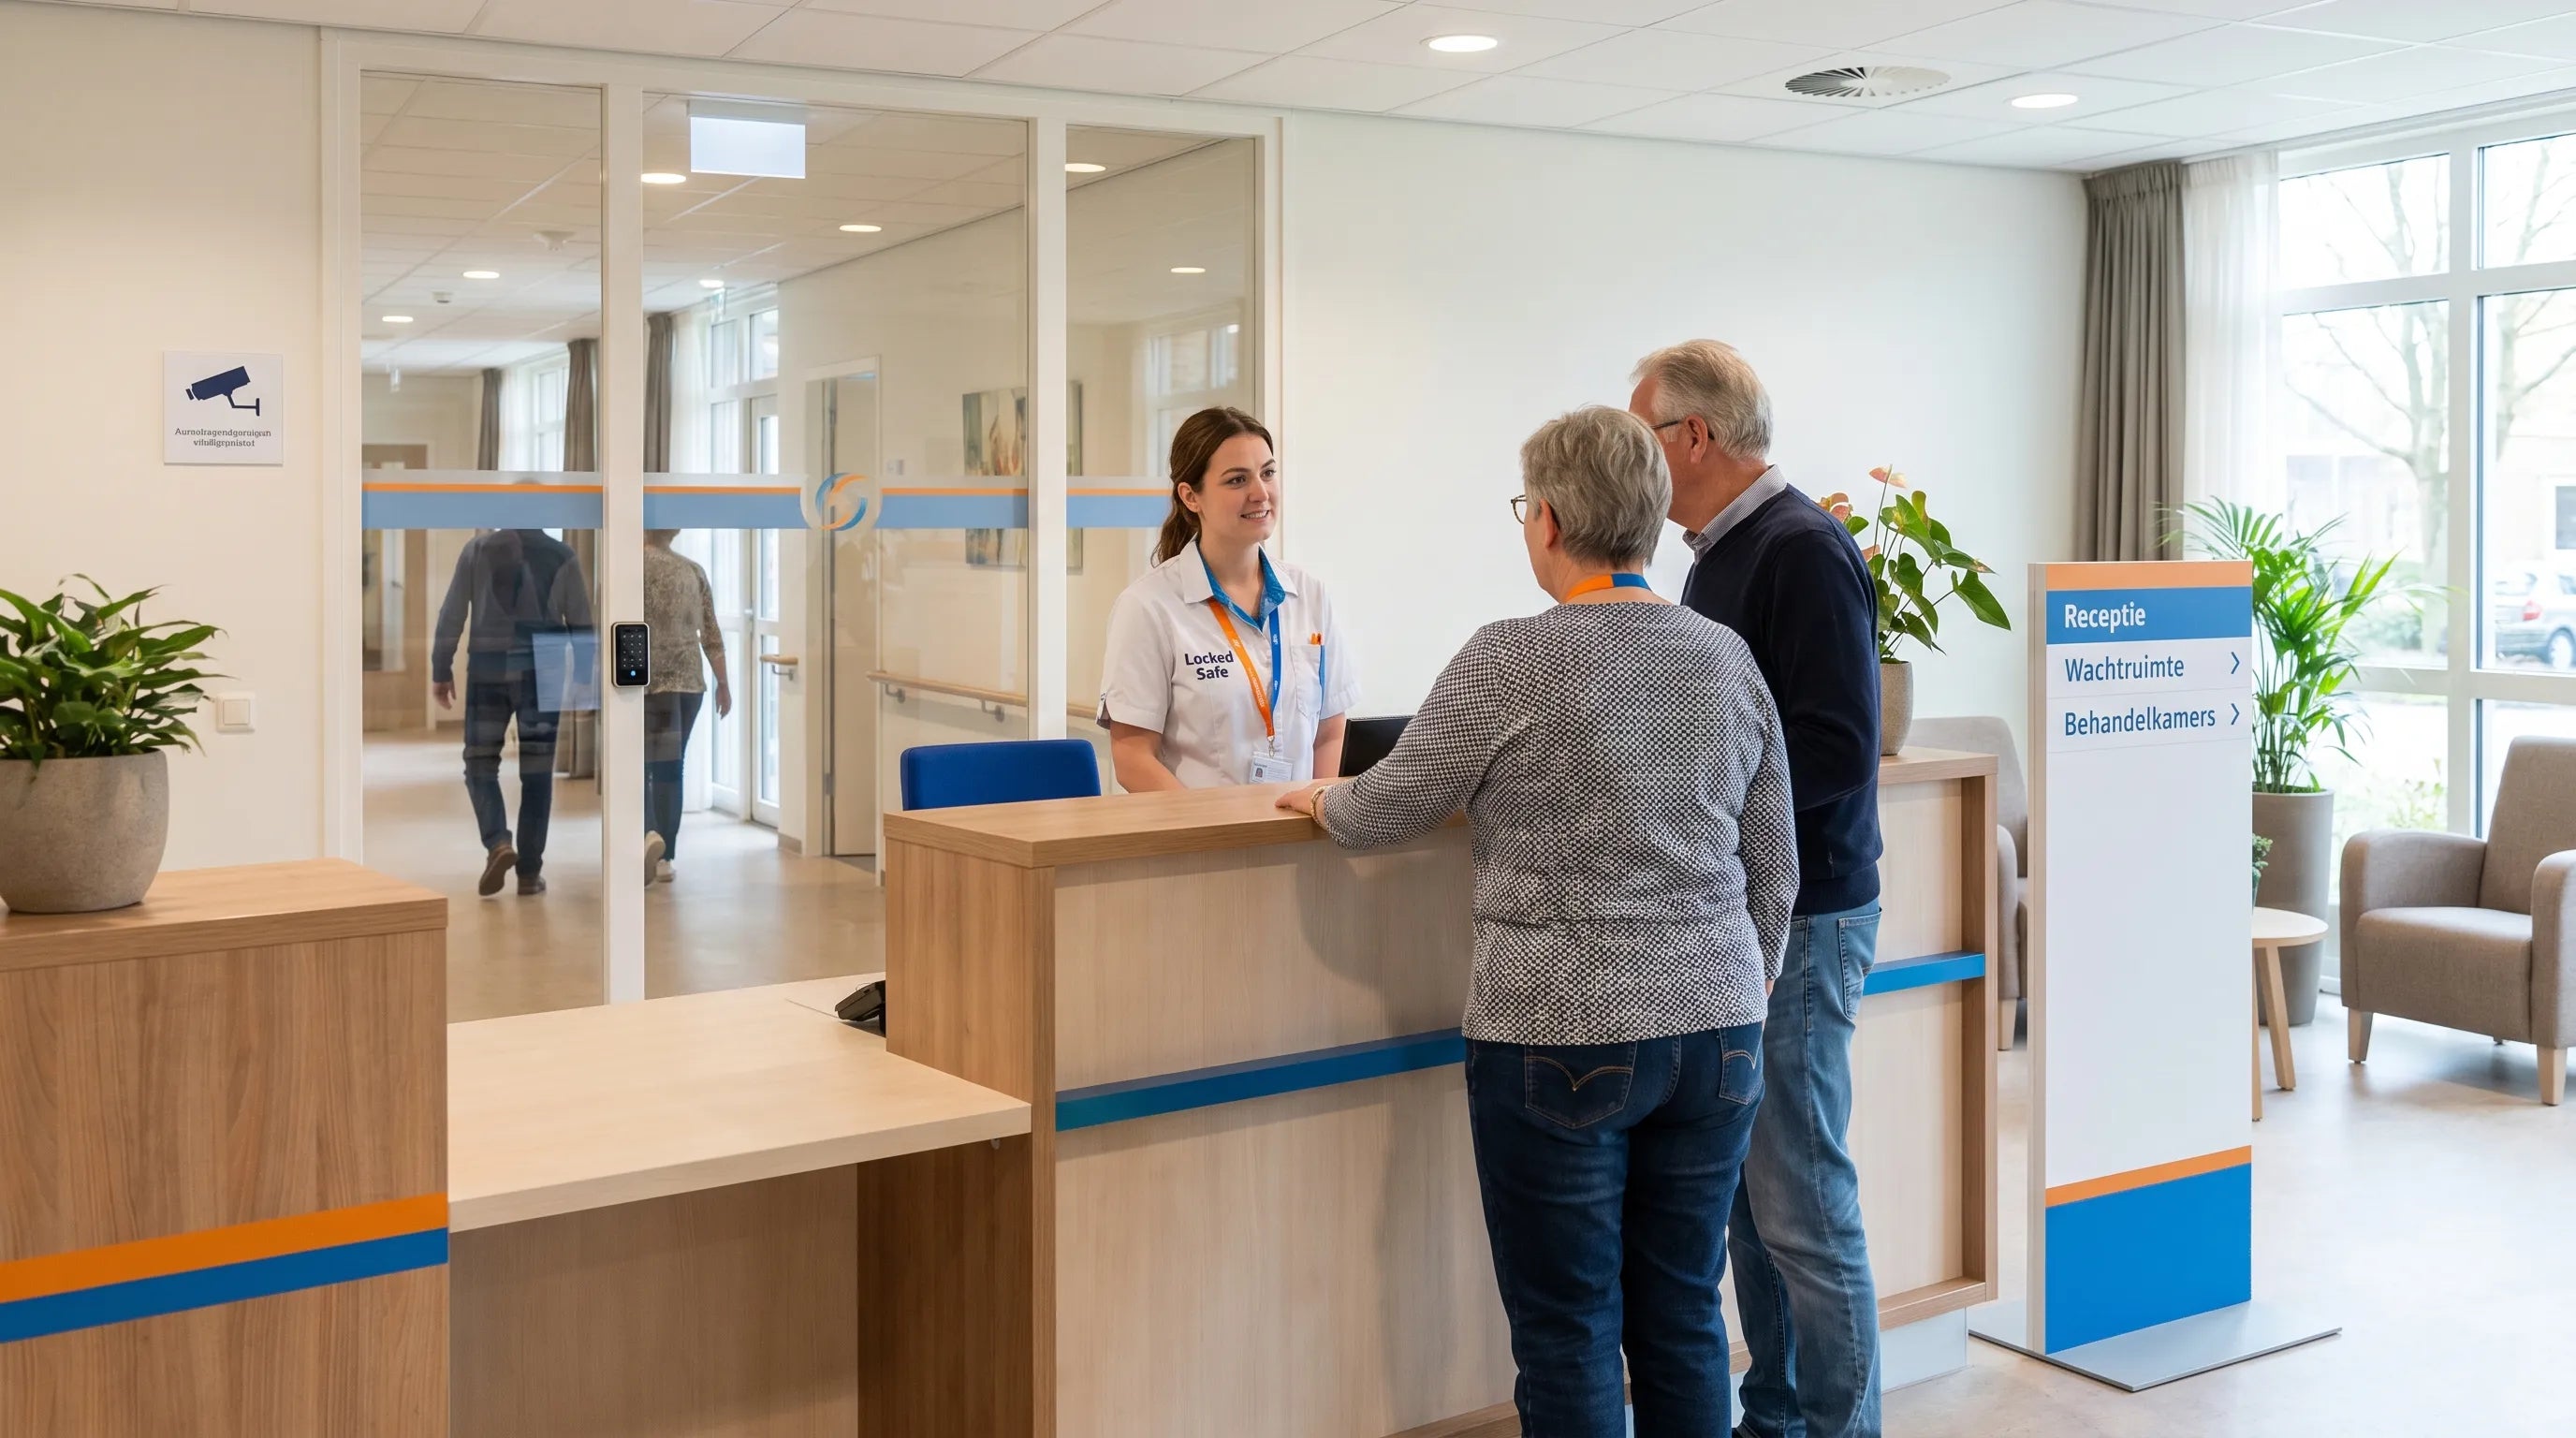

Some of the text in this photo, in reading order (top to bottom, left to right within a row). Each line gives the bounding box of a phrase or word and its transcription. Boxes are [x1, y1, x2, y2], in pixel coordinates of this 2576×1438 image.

[2065, 602, 2146, 634] Receptie
[1184, 651, 1234, 666] Locked
[2065, 654, 2185, 682] Wachtruimte
[1196, 666, 1229, 681] Safe
[2065, 707, 2216, 736] Behandelkamers
